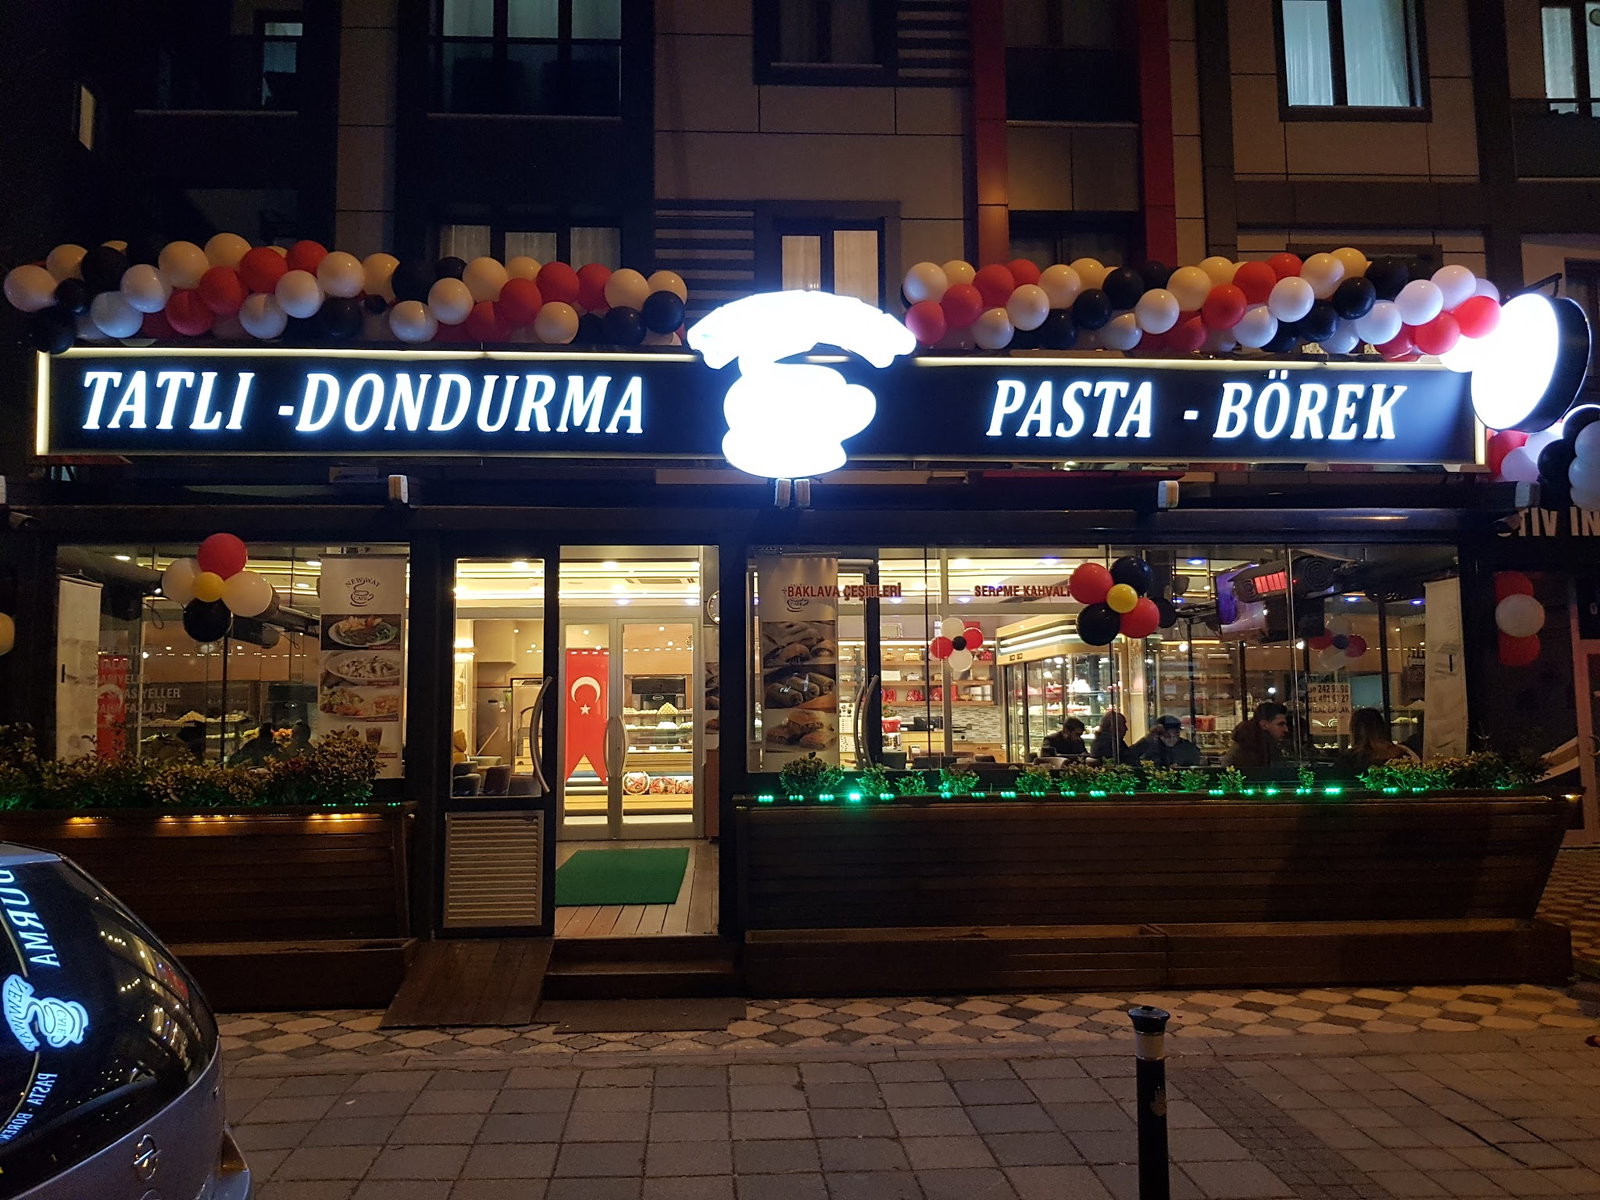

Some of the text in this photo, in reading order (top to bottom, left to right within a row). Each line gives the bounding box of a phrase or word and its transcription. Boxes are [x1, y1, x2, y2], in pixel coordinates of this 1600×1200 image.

[82, 370, 255, 430] TATLI
[986, 380, 1153, 438] PASTA
[1212, 370, 1408, 440] BÖREK
[787, 585, 840, 597] BAKLAVA
